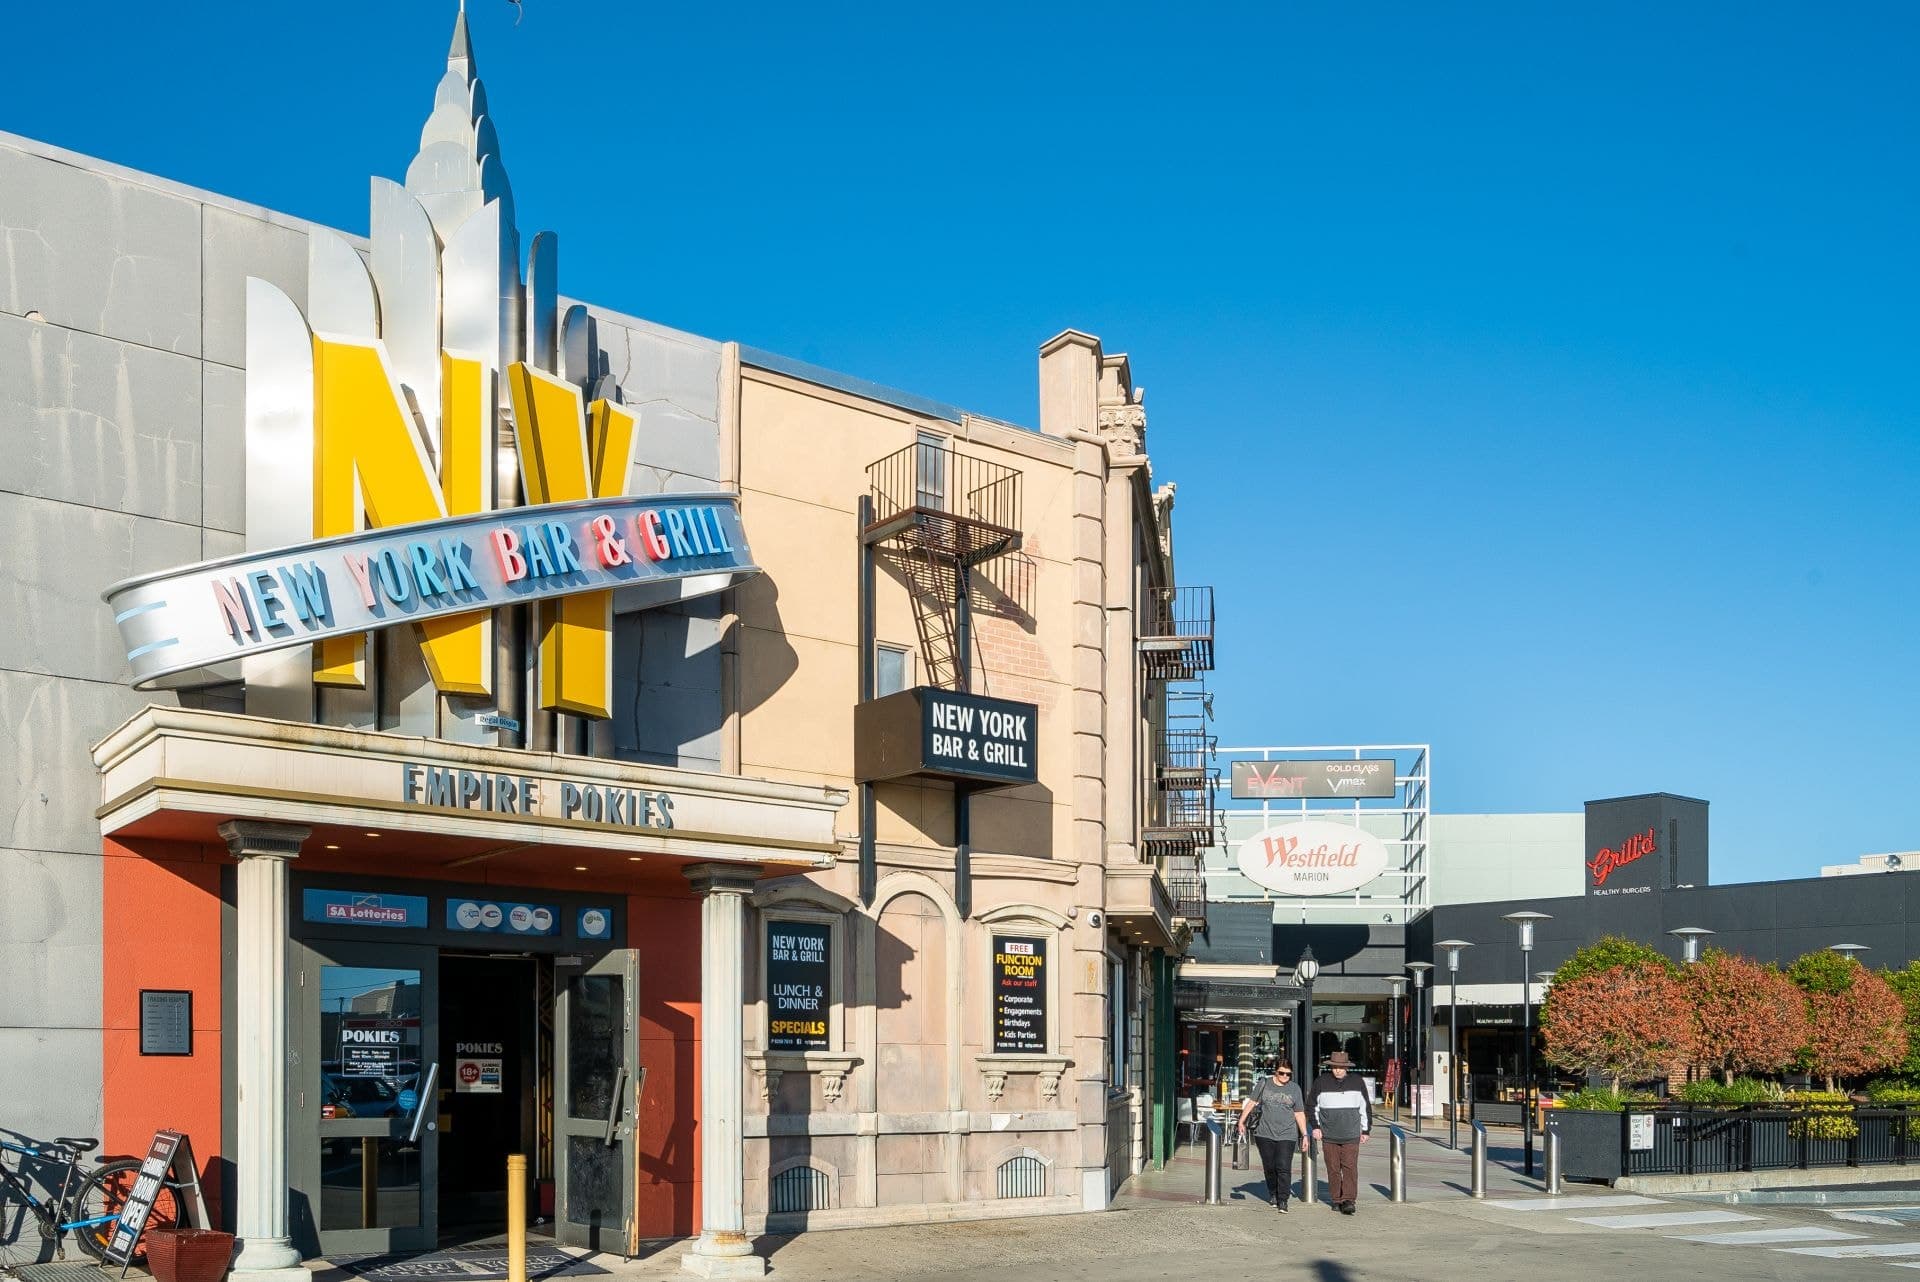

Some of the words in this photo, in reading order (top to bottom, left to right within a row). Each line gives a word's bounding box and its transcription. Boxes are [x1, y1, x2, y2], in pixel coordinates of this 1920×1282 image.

[312, 331, 641, 719] NY
[212, 561, 325, 636] NEW
[344, 535, 480, 608] YORK
[490, 520, 582, 584] BAR
[592, 514, 632, 568] &
[638, 507, 734, 561] GRILL
[932, 702, 975, 733] NEW
[979, 709, 1027, 741] YORK
[932, 733, 963, 759] BAR
[968, 739, 980, 761] &
[983, 741, 1028, 768] GRILL
[1326, 764, 1352, 772] GOLD
[1352, 764, 1380, 775] CLASS
[1247, 764, 1308, 795] EVENT
[1326, 777, 1366, 794] Vmax
[402, 762, 535, 816] EMPIRE
[560, 782, 674, 831] POKIES
[1261, 836, 1362, 869] Westfield
[1586, 826, 1657, 887] Grill'd
[1293, 872, 1330, 882] MARION
[1593, 886, 1620, 896] HEALTHY
[1622, 886, 1652, 895] BURGERS
[330, 906, 347, 917] SA
[350, 907, 404, 920] Lotteries
[772, 935, 796, 950] NEW
[798, 936, 825, 952] YORK
[1010, 944, 1029, 953] FREE
[772, 949, 790, 961] BAR
[791, 951, 798, 961] &
[800, 950, 825, 963] GRILL
[996, 953, 1043, 967] FUNCTION
[1004, 965, 1035, 977] ROOM
[773, 983, 811, 998] LUNCH
[814, 985, 823, 998] &
[1001, 979, 1012, 987] Ask
[1013, 980, 1023, 988] our
[1024, 979, 1038, 988] staff
[778, 997, 819, 1011] DINNER
[1003, 994, 1034, 1004] Corporate
[1003, 1006, 1043, 1017] Engagements
[771, 1020, 826, 1035] SPECIALS
[1003, 1018, 1031, 1029] Birthdays
[342, 1029, 400, 1043] POKIES
[1004, 1030, 1017, 1039] Kids
[1017, 1030, 1037, 1039] Parties
[456, 1042, 503, 1054] POKIES
[461, 1067, 478, 1076] 18+
